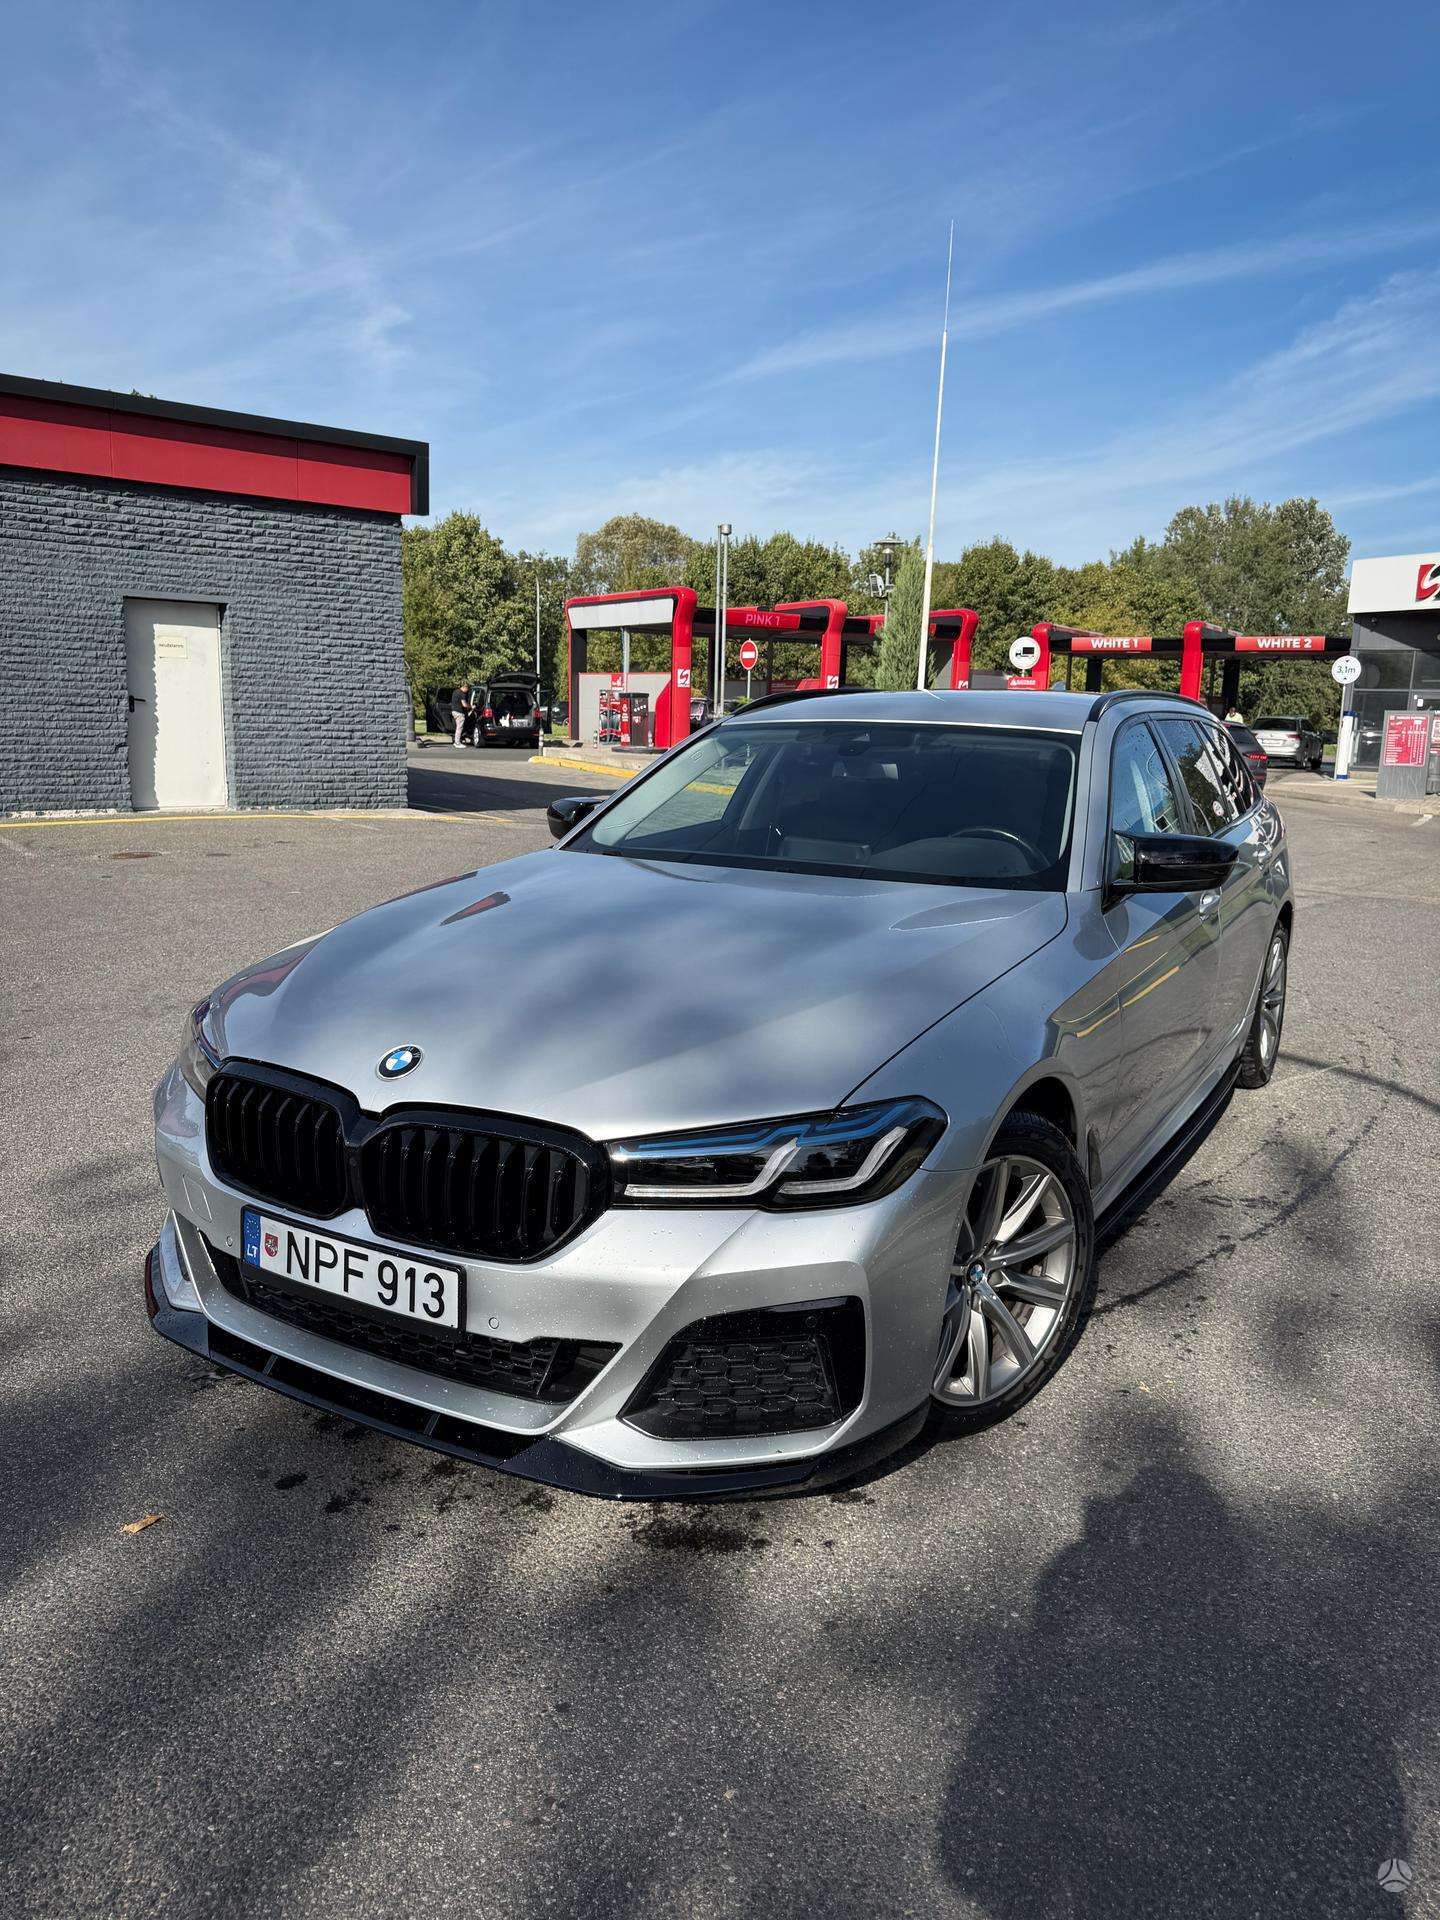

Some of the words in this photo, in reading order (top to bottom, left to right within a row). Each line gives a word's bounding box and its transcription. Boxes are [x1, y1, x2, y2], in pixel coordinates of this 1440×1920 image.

[745, 613, 773, 626] PINK
[774, 615, 781, 627] 1
[1090, 639, 1131, 649] WHITE
[1131, 639, 1139, 648] 1
[1257, 638, 1302, 649] WHITE
[1303, 638, 1313, 648] 2
[246, 1243, 258, 1258] LT
[286, 1230, 369, 1294] NPF
[377, 1259, 445, 1319] 913
